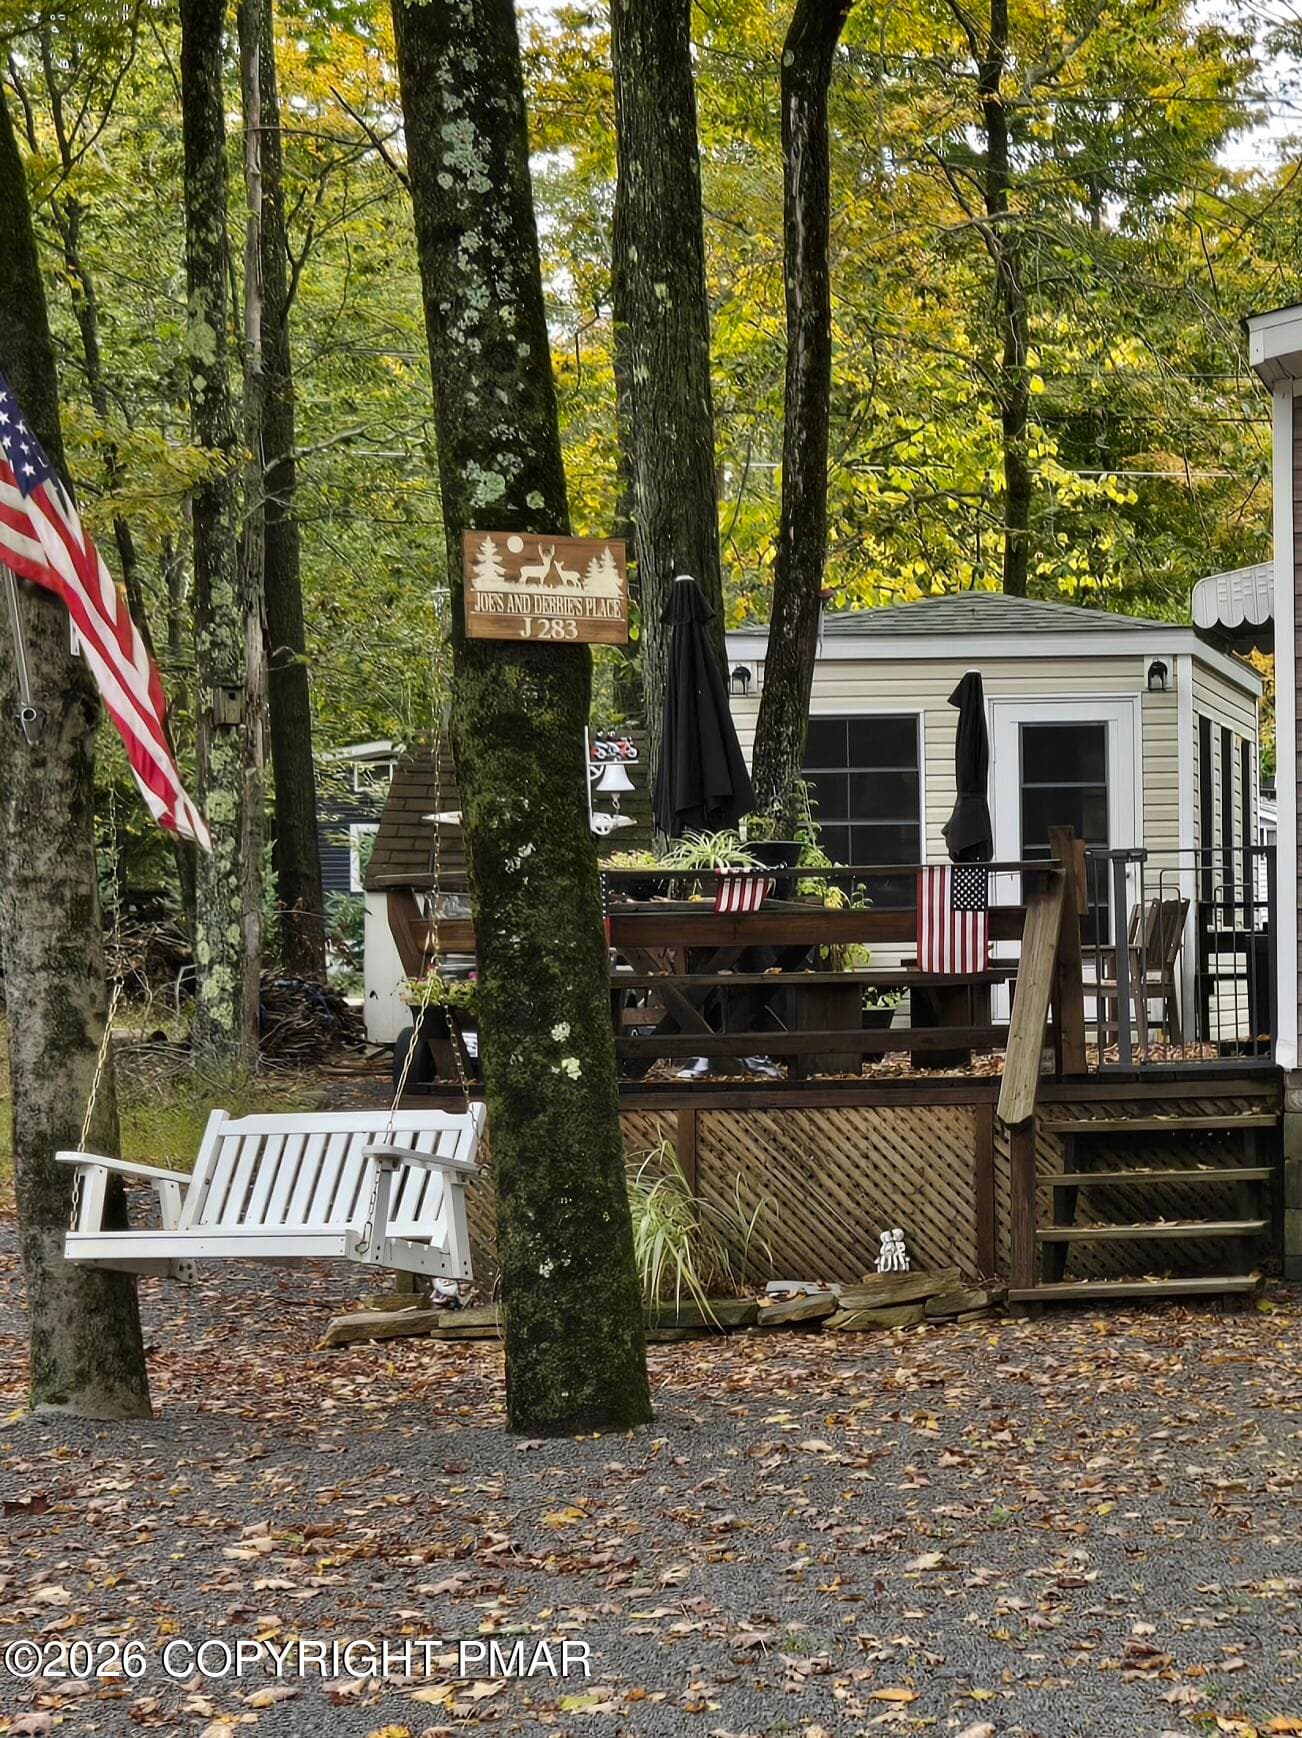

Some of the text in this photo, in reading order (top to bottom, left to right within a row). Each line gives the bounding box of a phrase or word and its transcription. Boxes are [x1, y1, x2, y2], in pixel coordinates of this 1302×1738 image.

[507, 593, 531, 614] AND
[586, 598, 621, 619] PLACE
[520, 617, 578, 640] J 283
